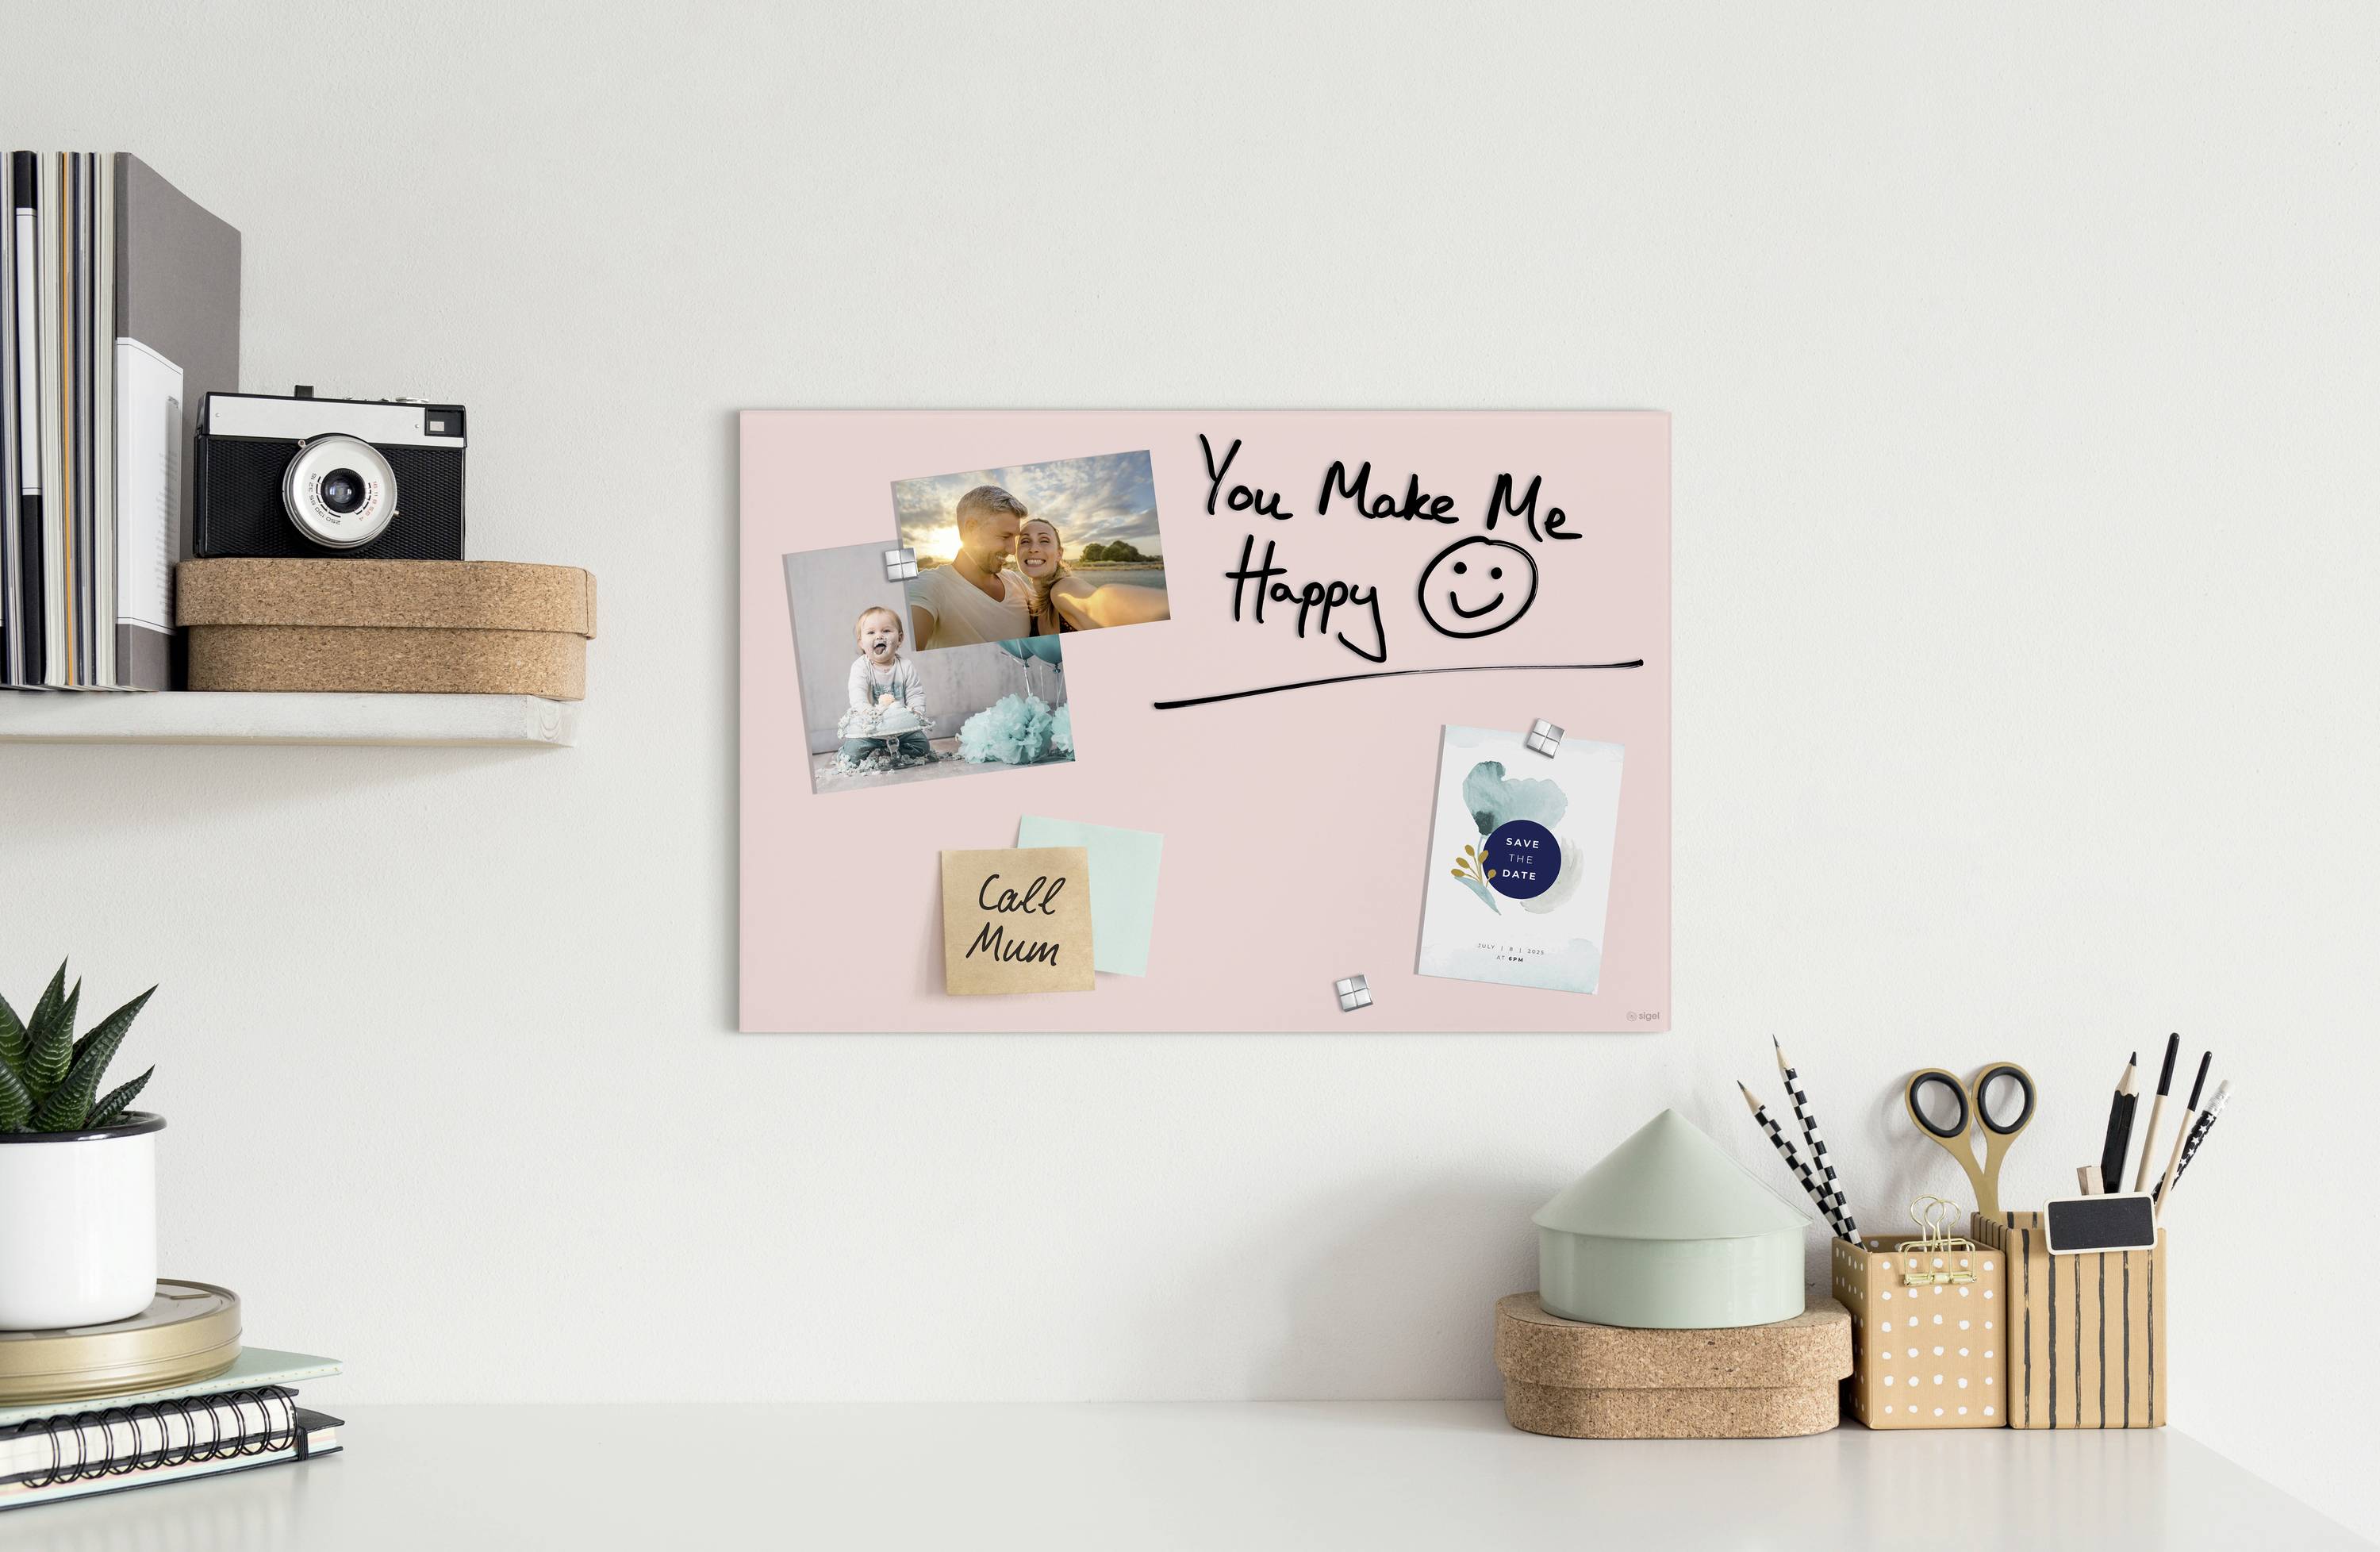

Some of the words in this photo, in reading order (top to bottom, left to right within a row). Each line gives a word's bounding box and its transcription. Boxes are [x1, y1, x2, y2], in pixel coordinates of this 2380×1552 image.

[1199, 433, 1294, 521] You
[1318, 460, 1460, 524] Make
[1486, 473, 1583, 543] Me
[325, 517, 341, 525] 250
[1225, 534, 1388, 663] Happy
[1506, 837, 1539, 849] SAVE
[1509, 853, 1533, 864] THE
[1502, 869, 1536, 881] DATE
[978, 874, 1066, 916] Call
[965, 921, 1060, 966] Mum
[1637, 1011, 1660, 1022] sigel
